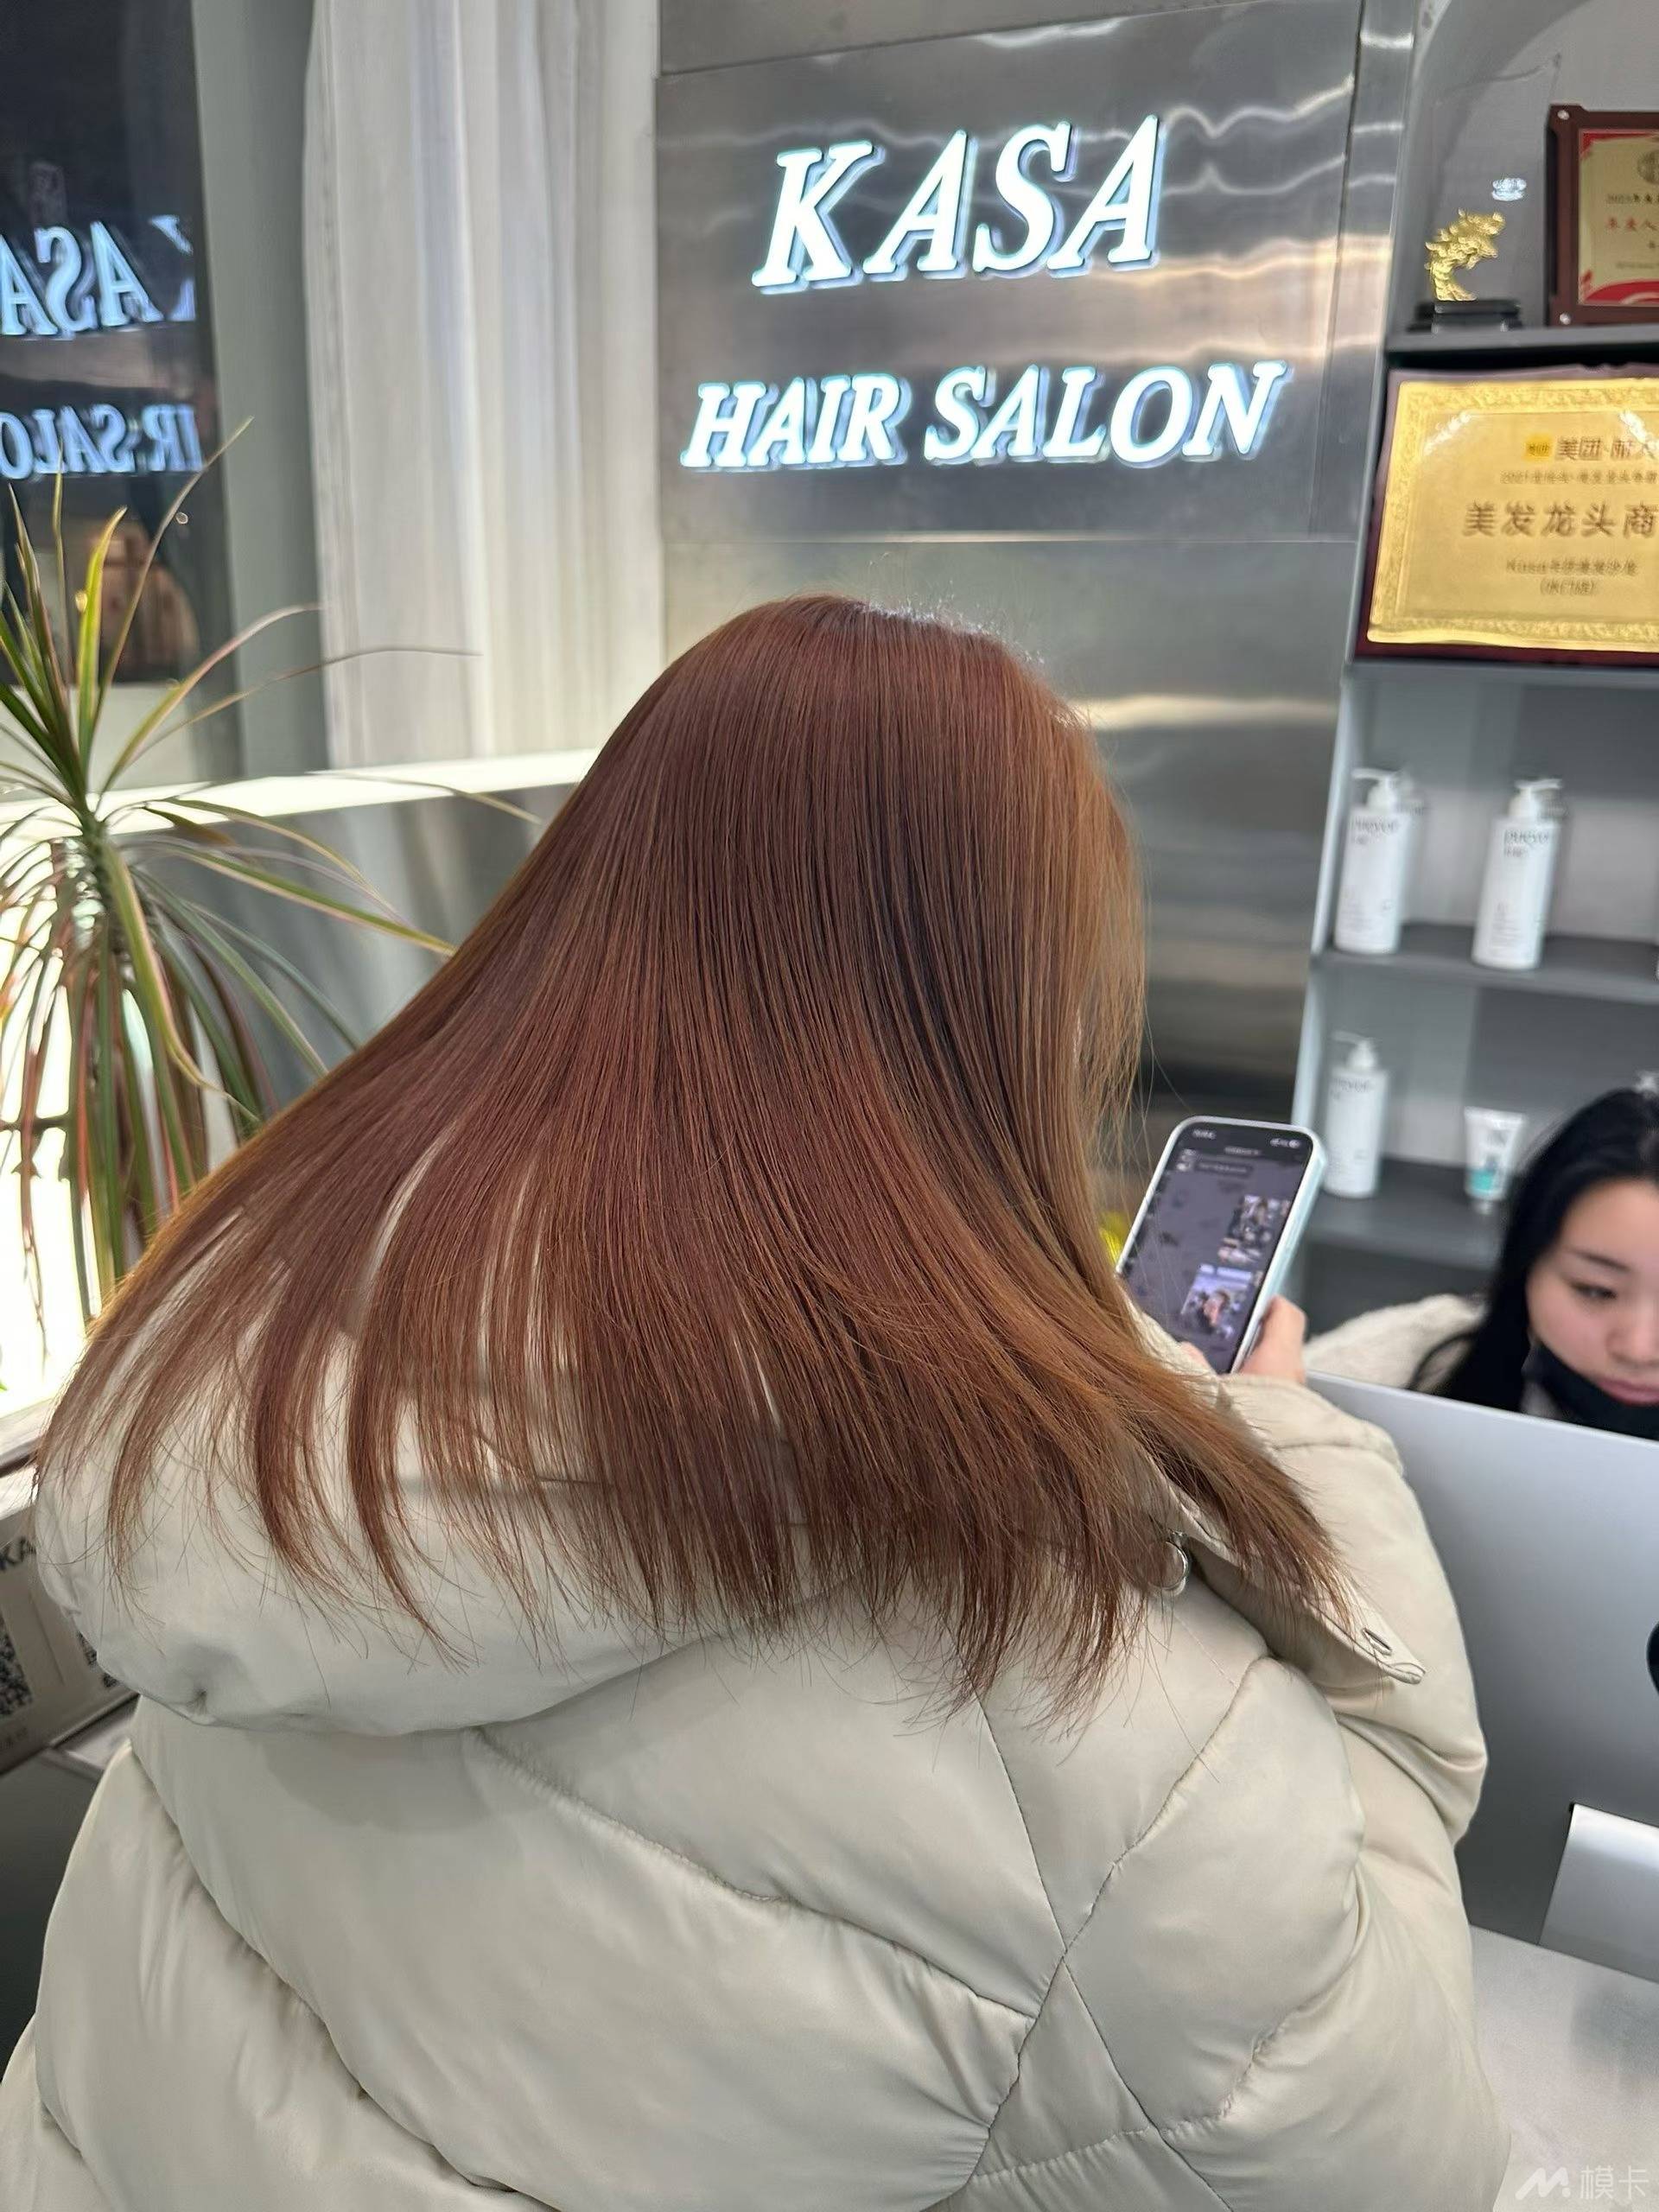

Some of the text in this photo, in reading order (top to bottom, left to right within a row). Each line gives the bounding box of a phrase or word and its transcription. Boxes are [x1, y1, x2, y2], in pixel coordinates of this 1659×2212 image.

[751, 114, 1165, 295] KASA
[680, 360, 1290, 471] HAIR SALON
